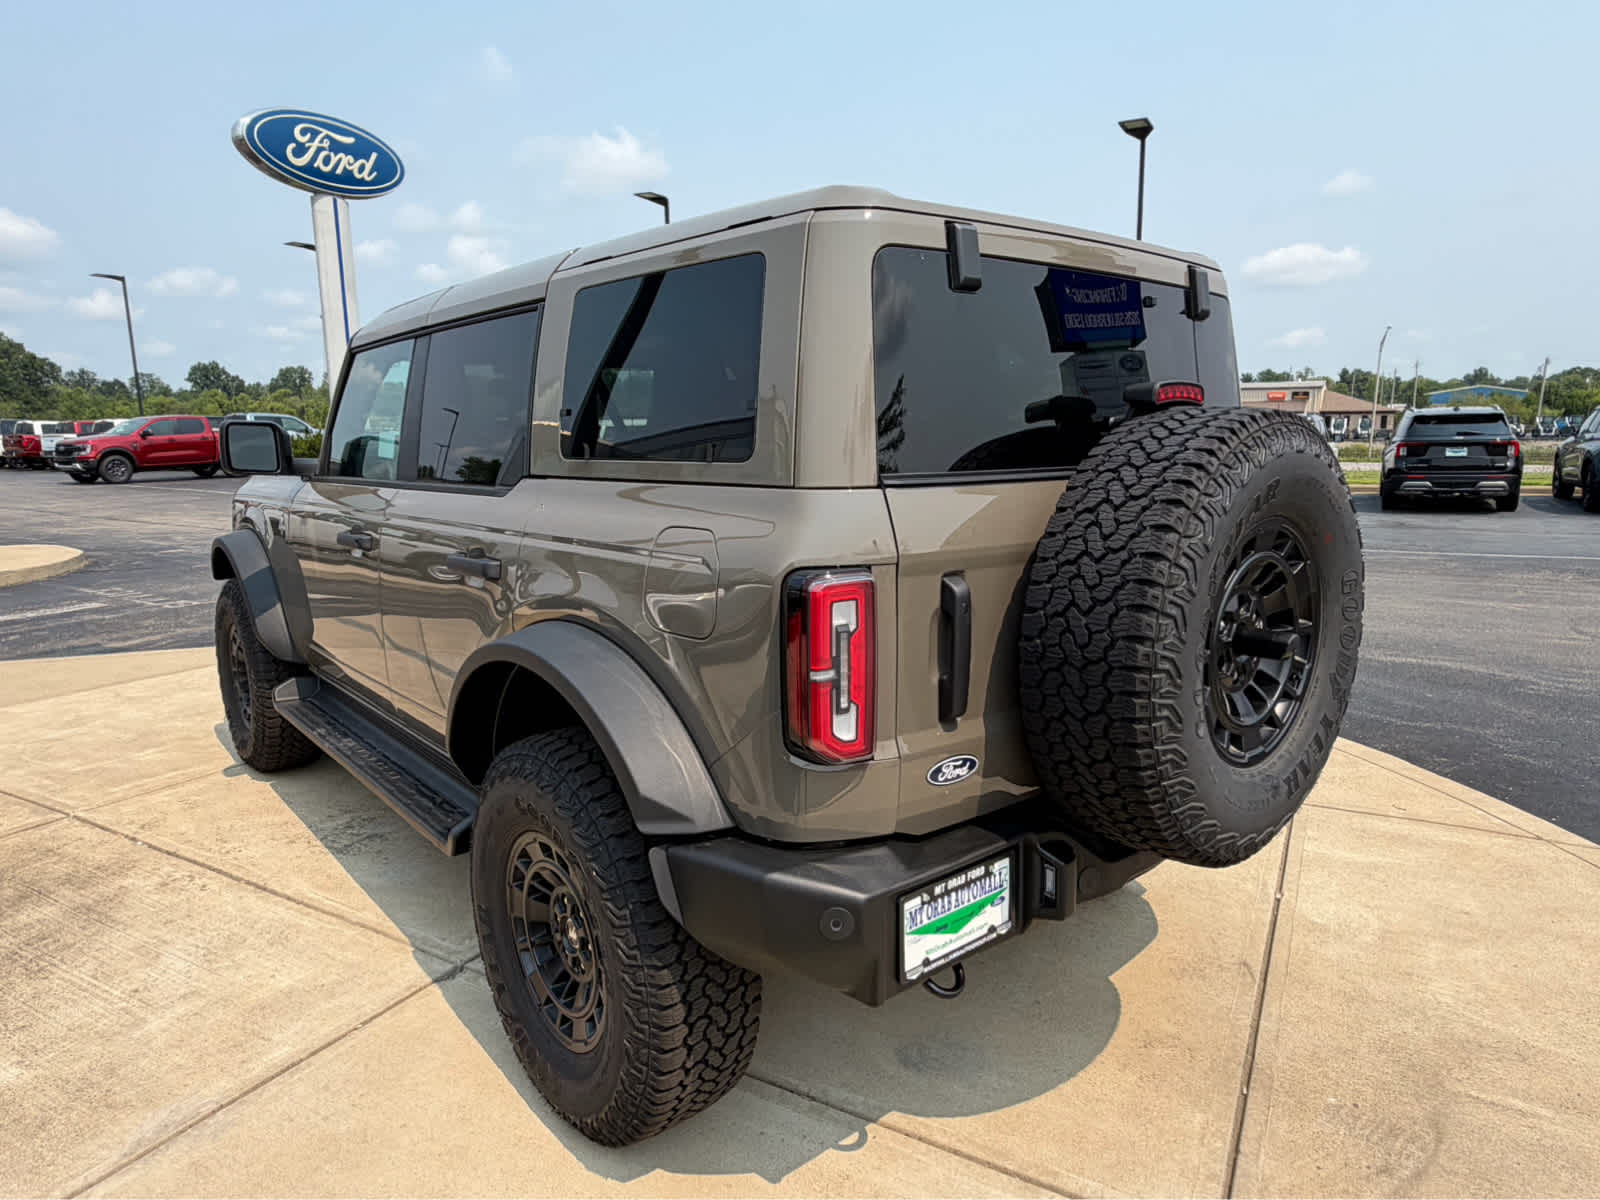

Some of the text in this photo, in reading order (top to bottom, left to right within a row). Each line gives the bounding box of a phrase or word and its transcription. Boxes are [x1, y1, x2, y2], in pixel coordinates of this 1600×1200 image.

[286, 123, 379, 181] Ford
[938, 760, 970, 781] Ford
[909, 907, 925, 930] MT
